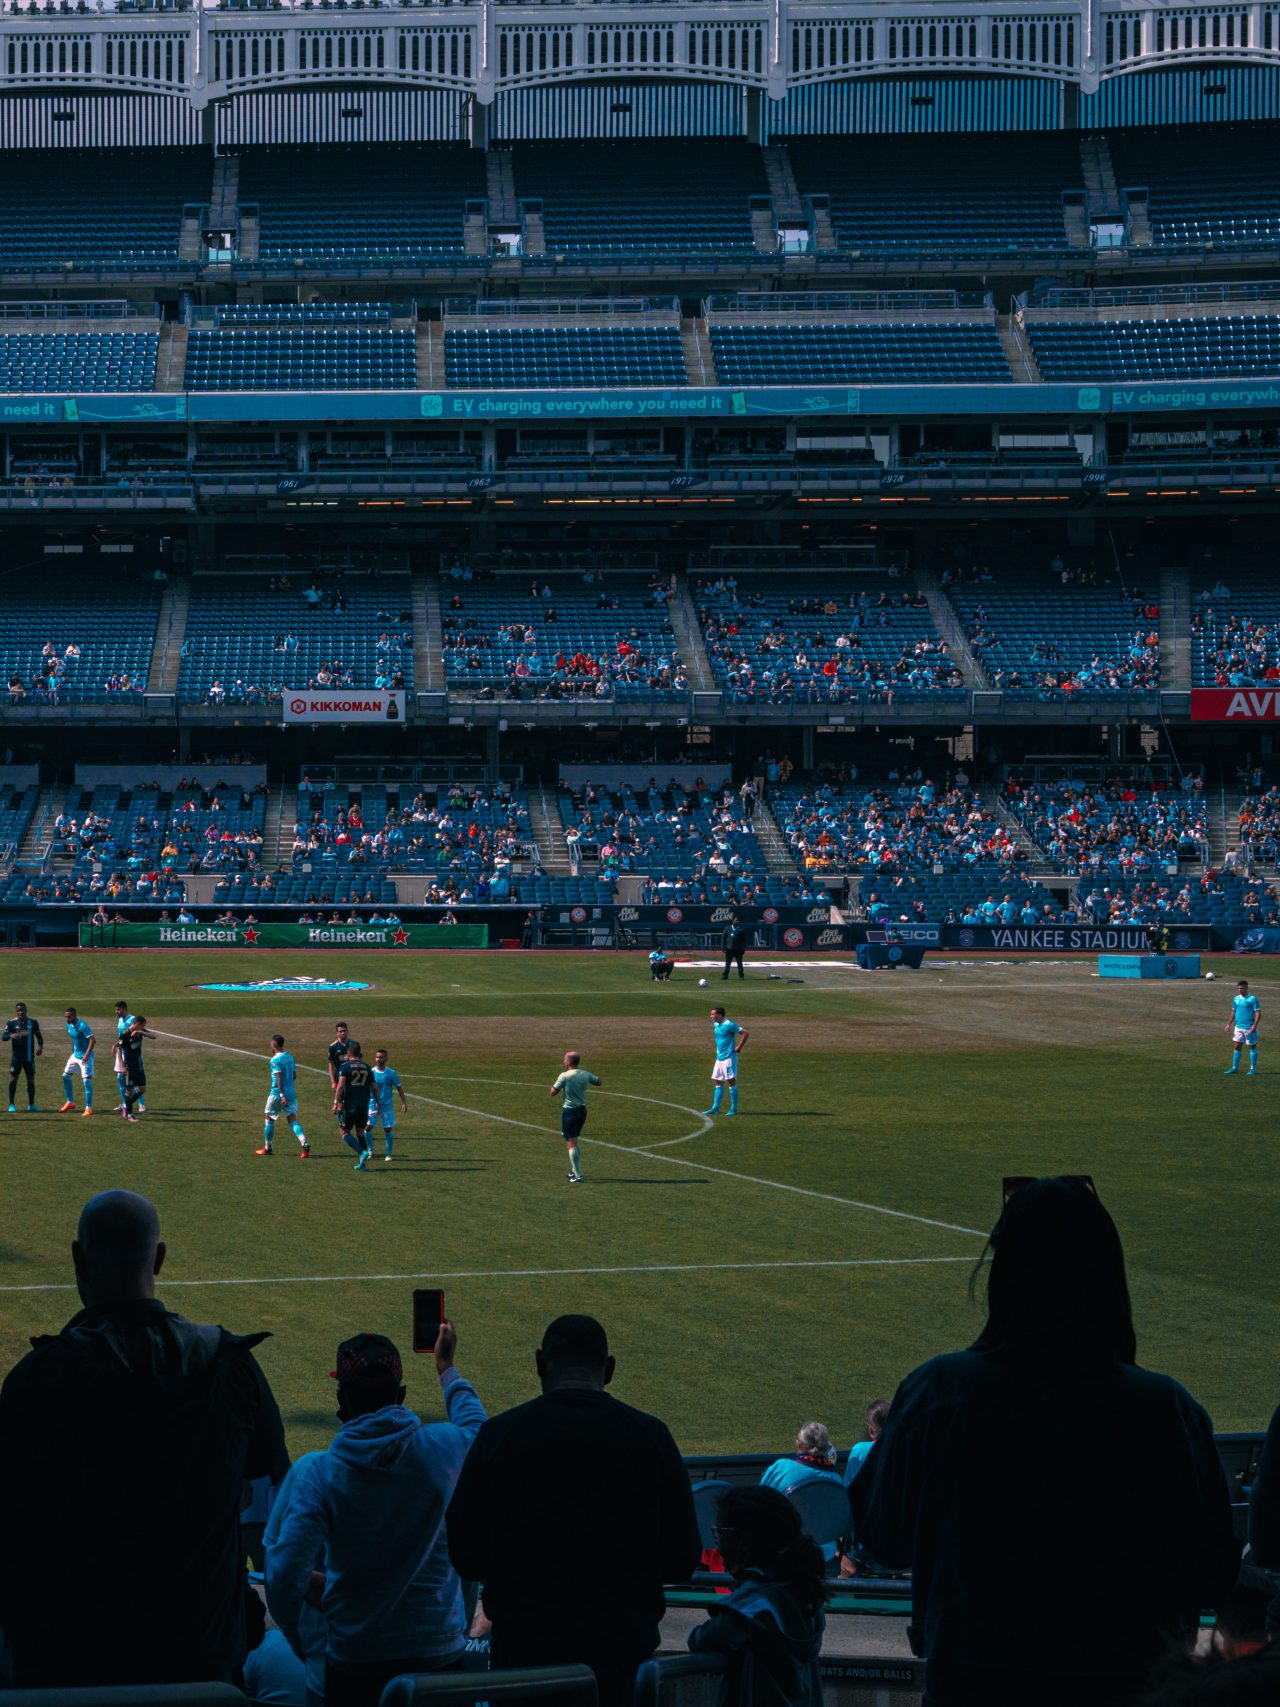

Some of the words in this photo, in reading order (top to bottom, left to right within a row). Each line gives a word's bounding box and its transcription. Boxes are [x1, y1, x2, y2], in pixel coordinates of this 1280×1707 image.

[1113, 391, 1134, 404] EV
[1139, 389, 1205, 406] charging
[4, 403, 39, 415] need
[44, 403, 54, 415] it
[453, 399, 474, 412] EV
[478, 397, 541, 414] charging
[546, 397, 633, 414] everywhere
[638, 399, 665, 413] you
[670, 396, 707, 409] need
[712, 396, 722, 409] it
[469, 478, 491, 487] 1962
[671, 476, 693, 485] 1977
[881, 474, 904, 483] 1978
[1083, 473, 1106, 482] 1996
[278, 480, 299, 488] 1961
[310, 701, 381, 712] KIKKOMAN
[159, 928, 237, 942] Heineken
[308, 928, 387, 942] Heineken
[901, 929, 939, 940] EICO
[991, 929, 1064, 948] YANKEE
[351, 1070, 368, 1086] 27
[820, 1666, 843, 1677] BATS
[846, 1666, 881, 1679] AND/OR
[883, 1669, 912, 1680] BALLS
